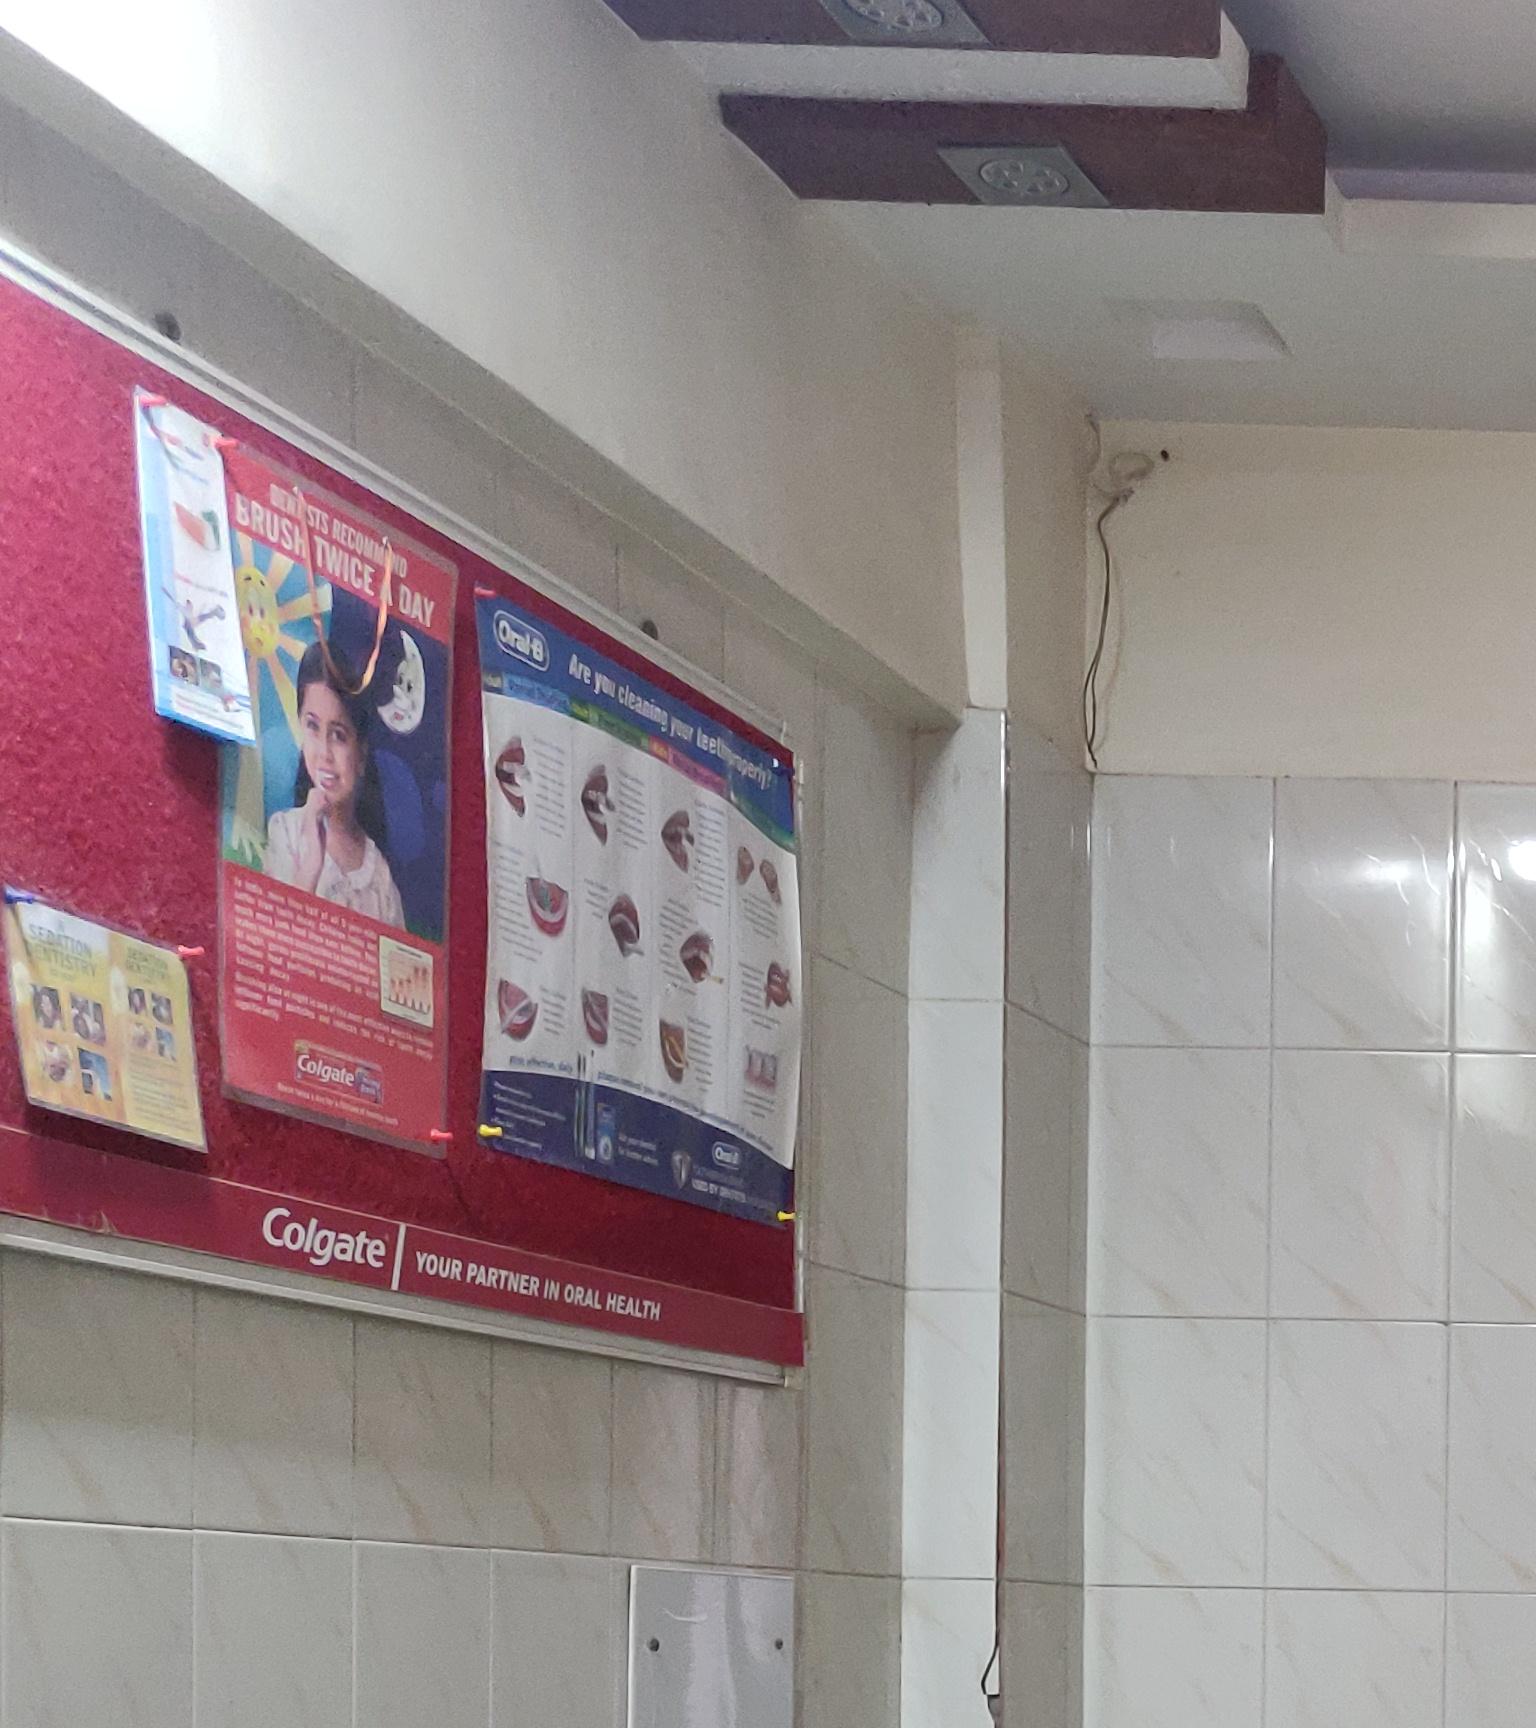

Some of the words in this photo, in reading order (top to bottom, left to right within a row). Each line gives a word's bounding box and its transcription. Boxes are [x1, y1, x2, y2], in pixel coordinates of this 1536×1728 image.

[234, 491, 306, 558] BRUSH
[314, 535, 375, 597] TWICE
[400, 584, 435, 629] DAY
[270, 483, 329, 534] DENTSTS
[333, 517, 408, 579] RECOMMND
[499, 619, 545, 663] Oral-B
[569, 653, 592, 685] Are
[594, 672, 616, 699] you
[618, 683, 670, 733] cleaning
[670, 718, 694, 745] your
[30, 924, 93, 959] SEDATION
[297, 1054, 356, 1086] Colgate
[262, 1207, 387, 1268] Colgate
[415, 1251, 463, 1282] YOUR
[465, 1262, 540, 1298] PARTNER
[543, 1279, 561, 1300] IN
[563, 1282, 602, 1312] ORAL
[605, 1293, 662, 1322] HEALTH
